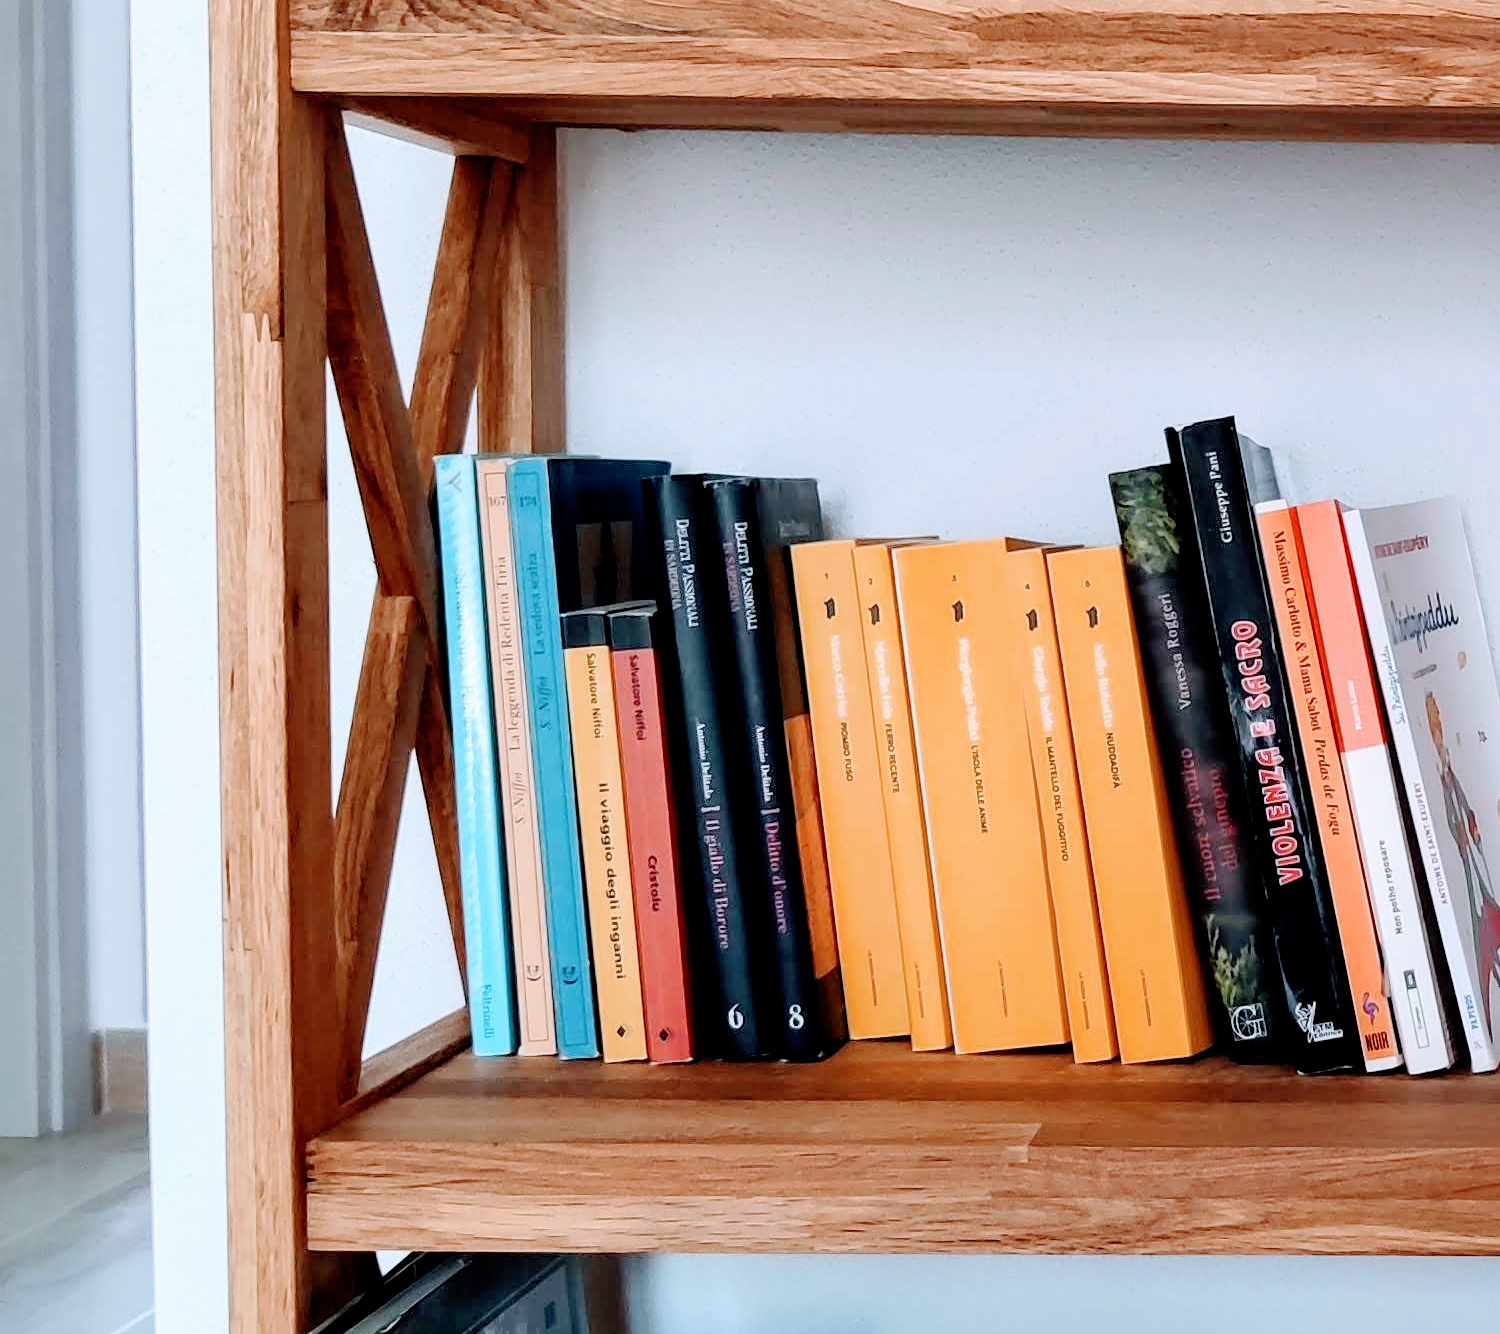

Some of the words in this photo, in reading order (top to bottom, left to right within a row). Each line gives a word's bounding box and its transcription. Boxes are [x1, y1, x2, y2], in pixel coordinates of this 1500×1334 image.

[1204, 451, 1222, 480] Pani
[1215, 482, 1234, 544] Giuseppe
[496, 555, 508, 587] Tiria
[1272, 530, 1292, 585] Massimo
[499, 591, 512, 649] Redenta
[682, 563, 700, 629] PASSIONALI
[741, 565, 759, 631] PASSIONALI
[1158, 593, 1181, 650] Roggeri
[1285, 587, 1303, 638] Carlotto
[585, 652, 598, 704] Salvatore
[628, 654, 642, 707] Salvatore
[1176, 649, 1193, 711] Vanessa
[1230, 619, 1273, 711] SACRO
[1298, 654, 1315, 694] Mama
[505, 670, 521, 734] leggenda
[591, 706, 601, 740] Niffoi
[633, 707, 647, 742] Niffoi
[1306, 694, 1321, 732] Sabot
[1250, 718, 1277, 738] E
[888, 754, 901, 794] RECENTE
[1106, 732, 1122, 790] NUDDADIFÀ
[1313, 738, 1330, 782] Perdas
[1047, 745, 1061, 793] MANTELLO
[1056, 811, 1070, 863] FUGGITIVO
[1254, 746, 1304, 886] VIOLENZA
[1326, 800, 1341, 837] Fogu
[599, 805, 614, 862] viaggio
[765, 820, 784, 873] Delitto
[647, 855, 661, 913] Cristolu
[1378, 838, 1394, 884] reposare
[1433, 865, 1449, 905] ANTOINE
[604, 866, 620, 911] degli
[1387, 884, 1403, 914] potho
[609, 915, 627, 981] inganni
[727, 1003, 744, 1030] 6
[788, 1003, 805, 1030] 8
[1364, 1030, 1390, 1053] NOIR
